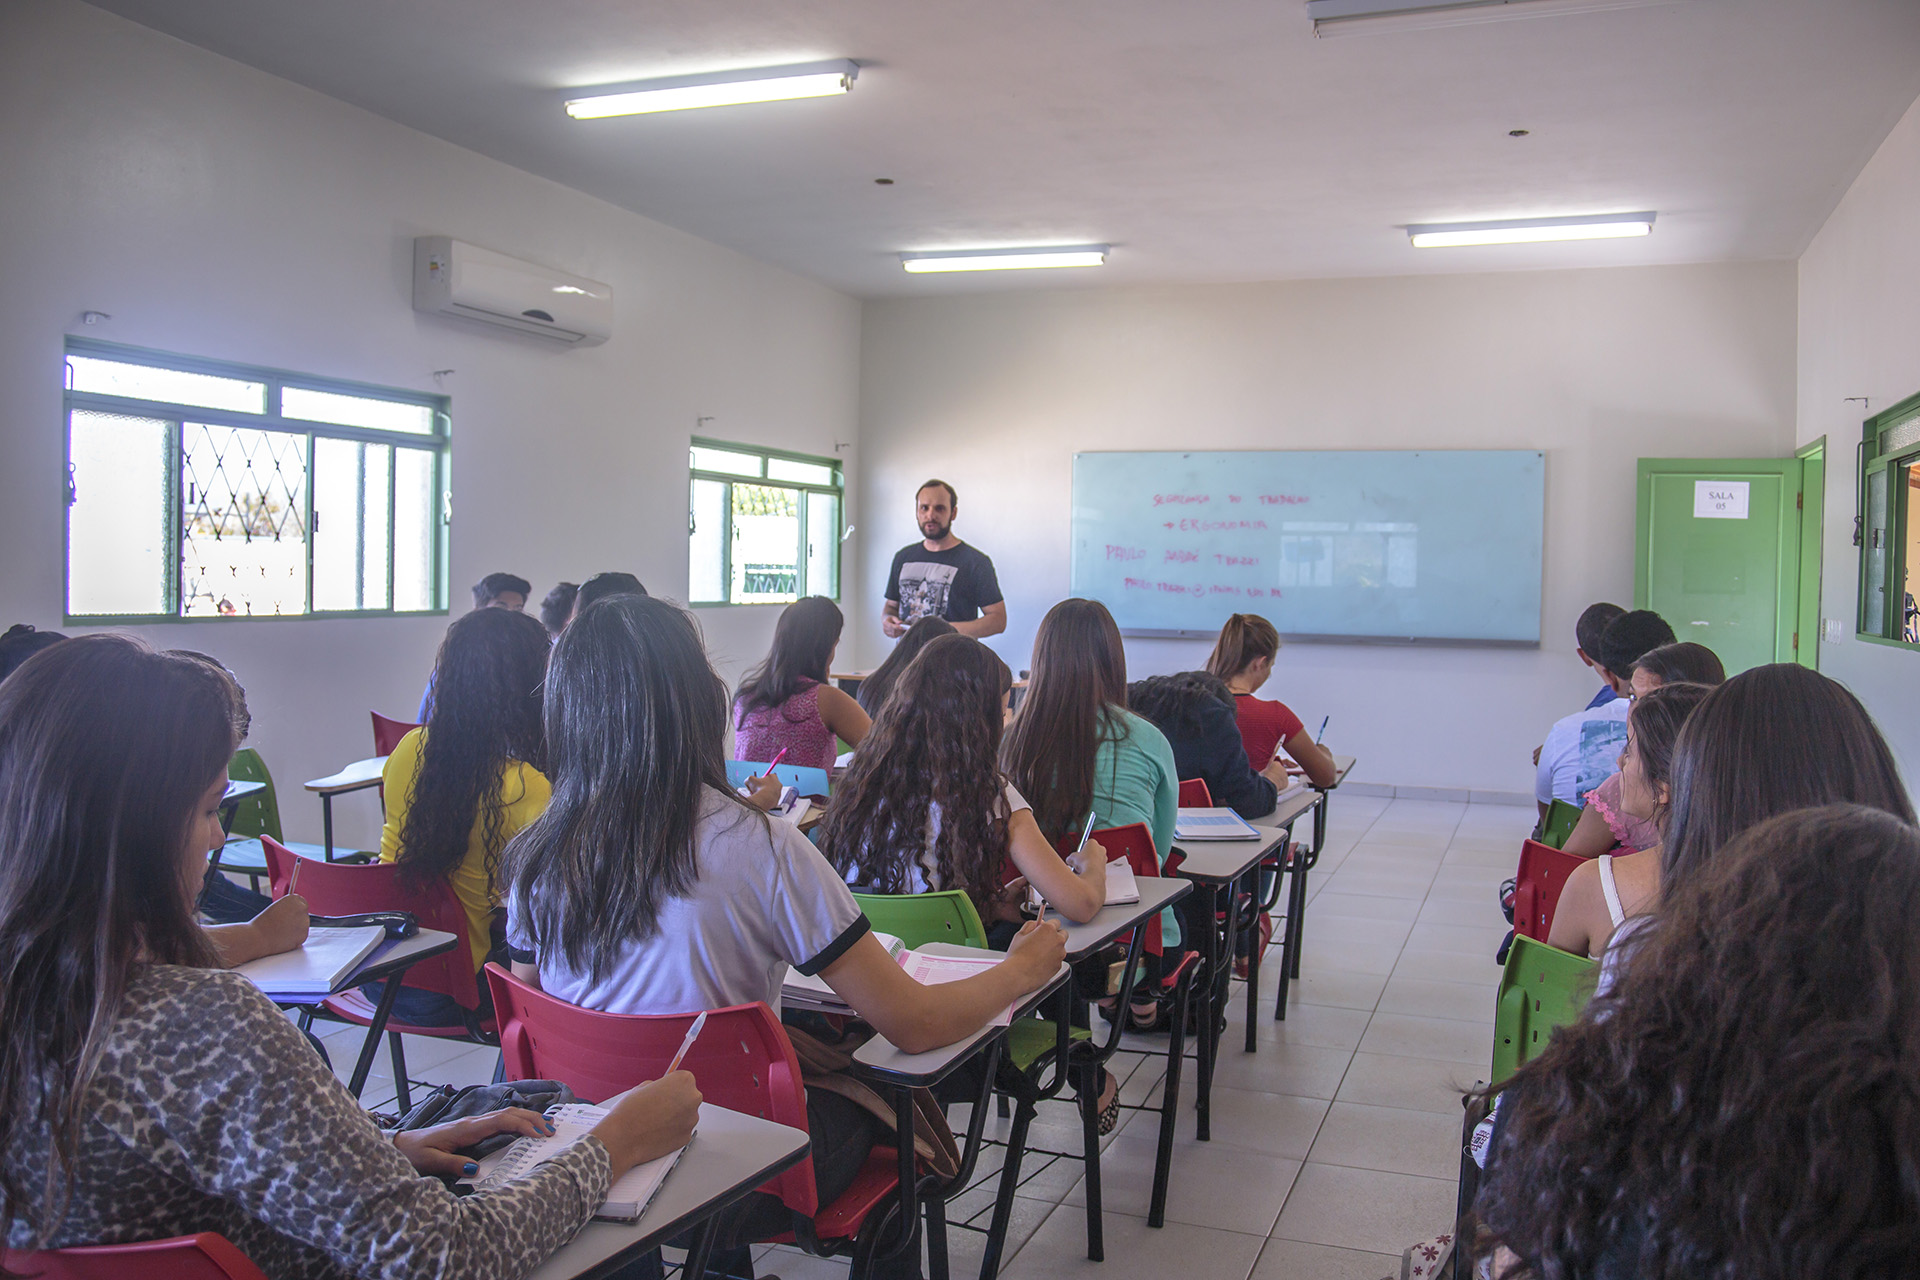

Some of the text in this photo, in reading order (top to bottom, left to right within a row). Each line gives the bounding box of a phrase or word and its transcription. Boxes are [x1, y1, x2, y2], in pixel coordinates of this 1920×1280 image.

[1709, 491, 1734, 500] SALA
[1715, 502, 1726, 510] 05
[1179, 518, 1268, 532] ERGONOMIA
[1105, 544, 1146, 561] PAULO
